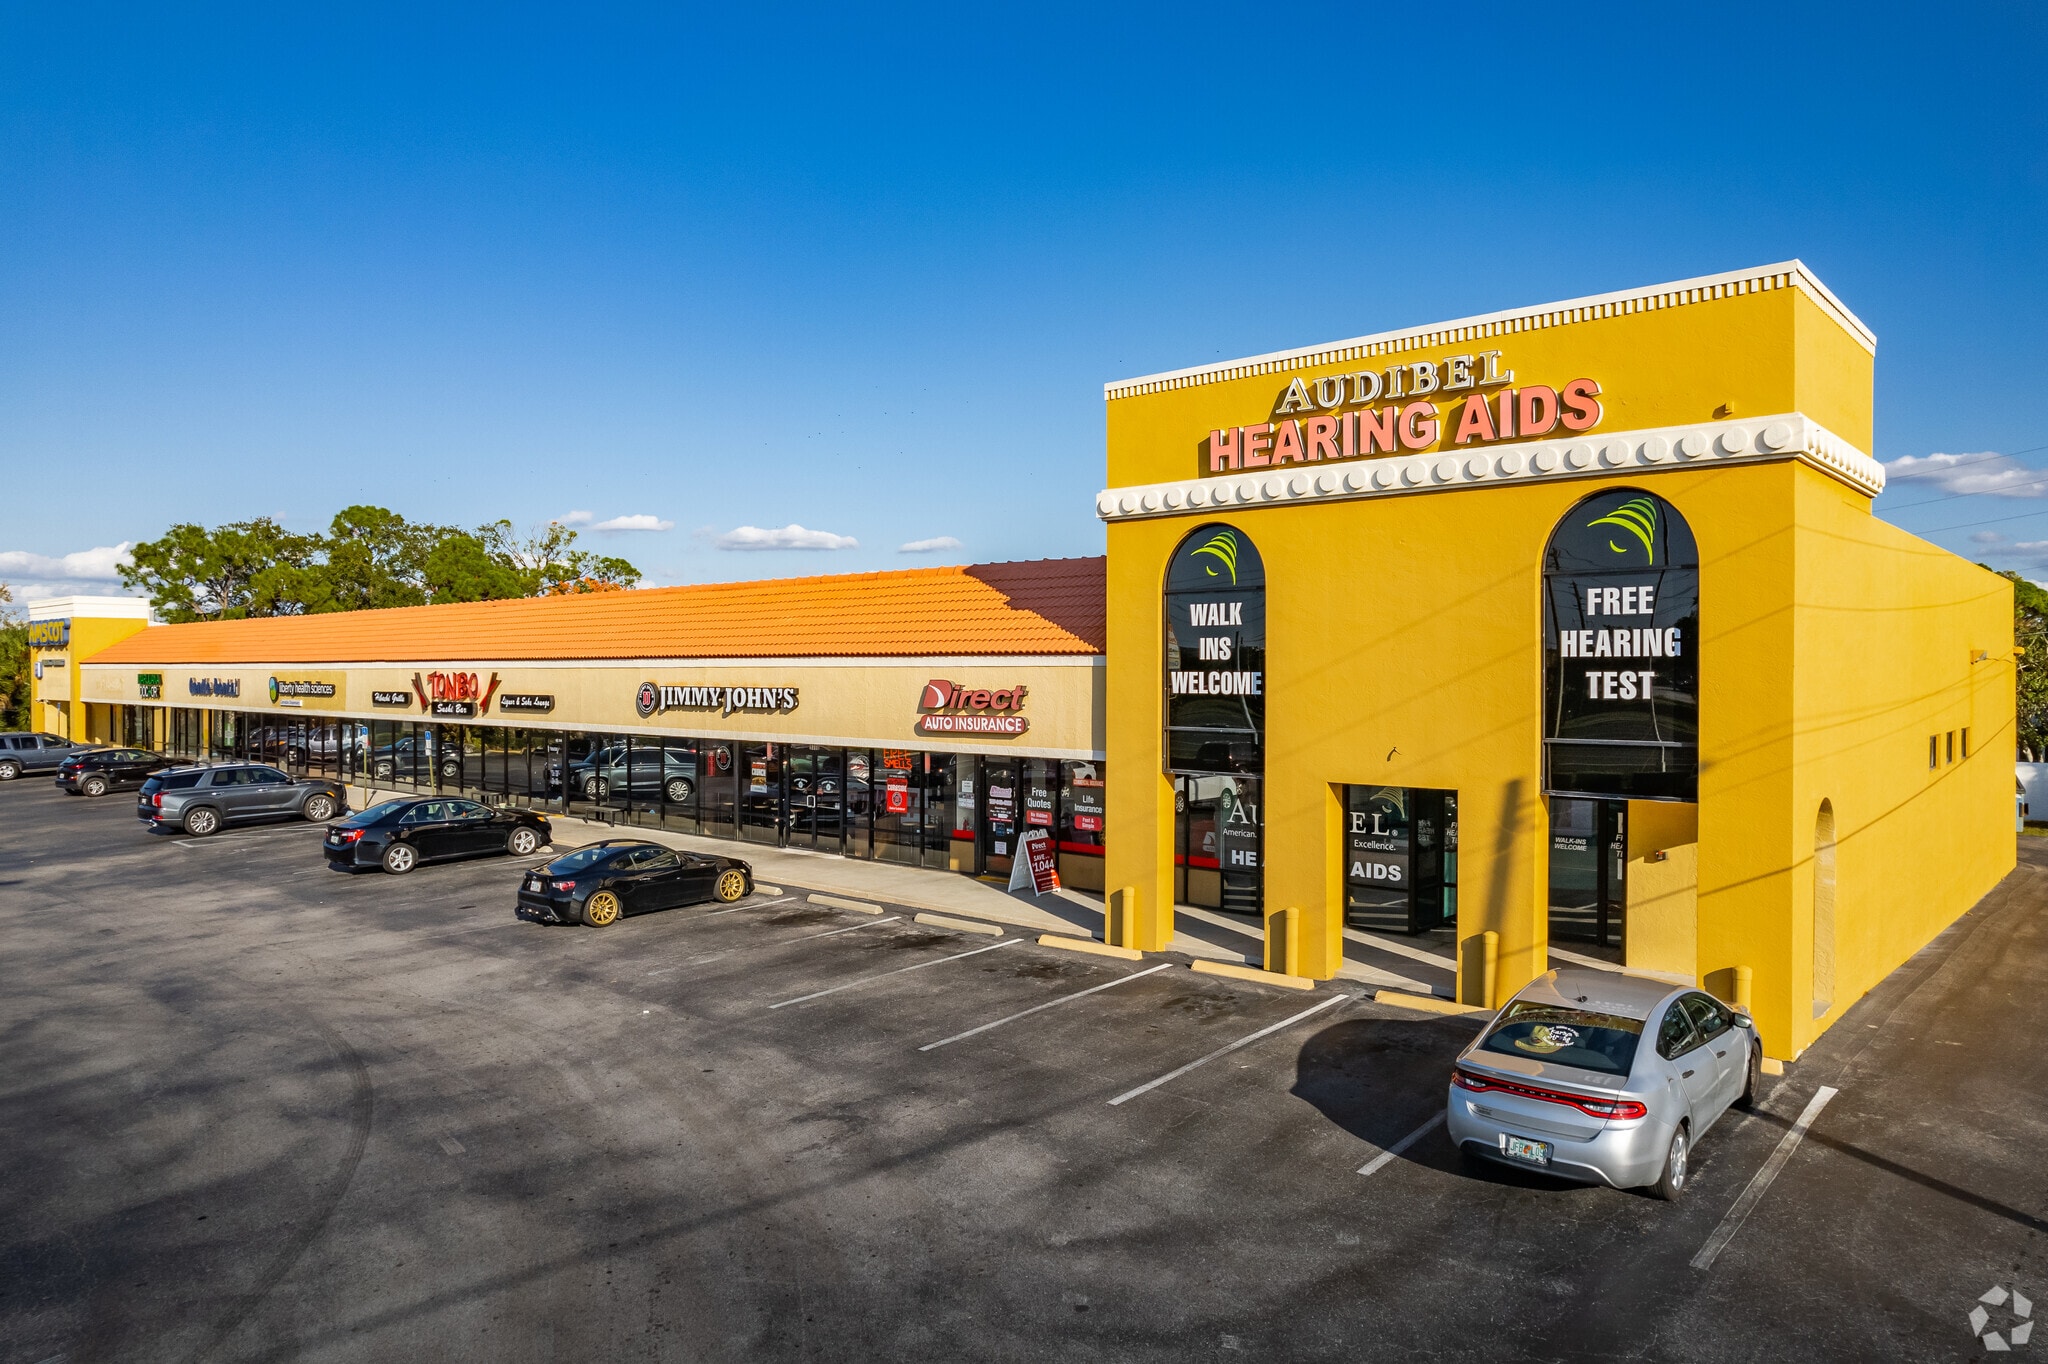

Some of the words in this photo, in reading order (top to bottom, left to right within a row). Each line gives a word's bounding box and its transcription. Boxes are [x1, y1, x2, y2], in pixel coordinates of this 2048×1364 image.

[1276, 350, 1514, 414] AUDIBEL
[1209, 401, 1439, 472] HEARING
[1454, 378, 1602, 444] AIDS
[1587, 586, 1653, 616] FREE
[1190, 602, 1243, 627] WALK
[1199, 636, 1232, 661] INS
[1561, 627, 1681, 658] HEARING
[311, 682, 333, 695] sciences
[427, 671, 479, 700] TONBO
[1171, 671, 1262, 695] WELCOME
[1585, 671, 1655, 700] TEST
[659, 686, 720, 710] JIMMY
[725, 687, 794, 713] JOHN'S
[923, 679, 1024, 711] Direct
[455, 704, 468, 714] Bar
[924, 716, 953, 730] AUTO
[955, 717, 1022, 732] INSURANCE
[883, 758, 913, 771] SMELLS
[1031, 787, 1047, 798] Free
[1082, 795, 1094, 804] Life
[1027, 797, 1051, 809] Quotes
[1074, 803, 1103, 813] Insurance
[1354, 839, 1396, 851] Excellence.
[1554, 843, 1587, 852] WELCOME
[1555, 836, 1587, 846] WALK-INS
[1033, 854, 1045, 862] SAVE
[1350, 861, 1402, 882] AIDS
